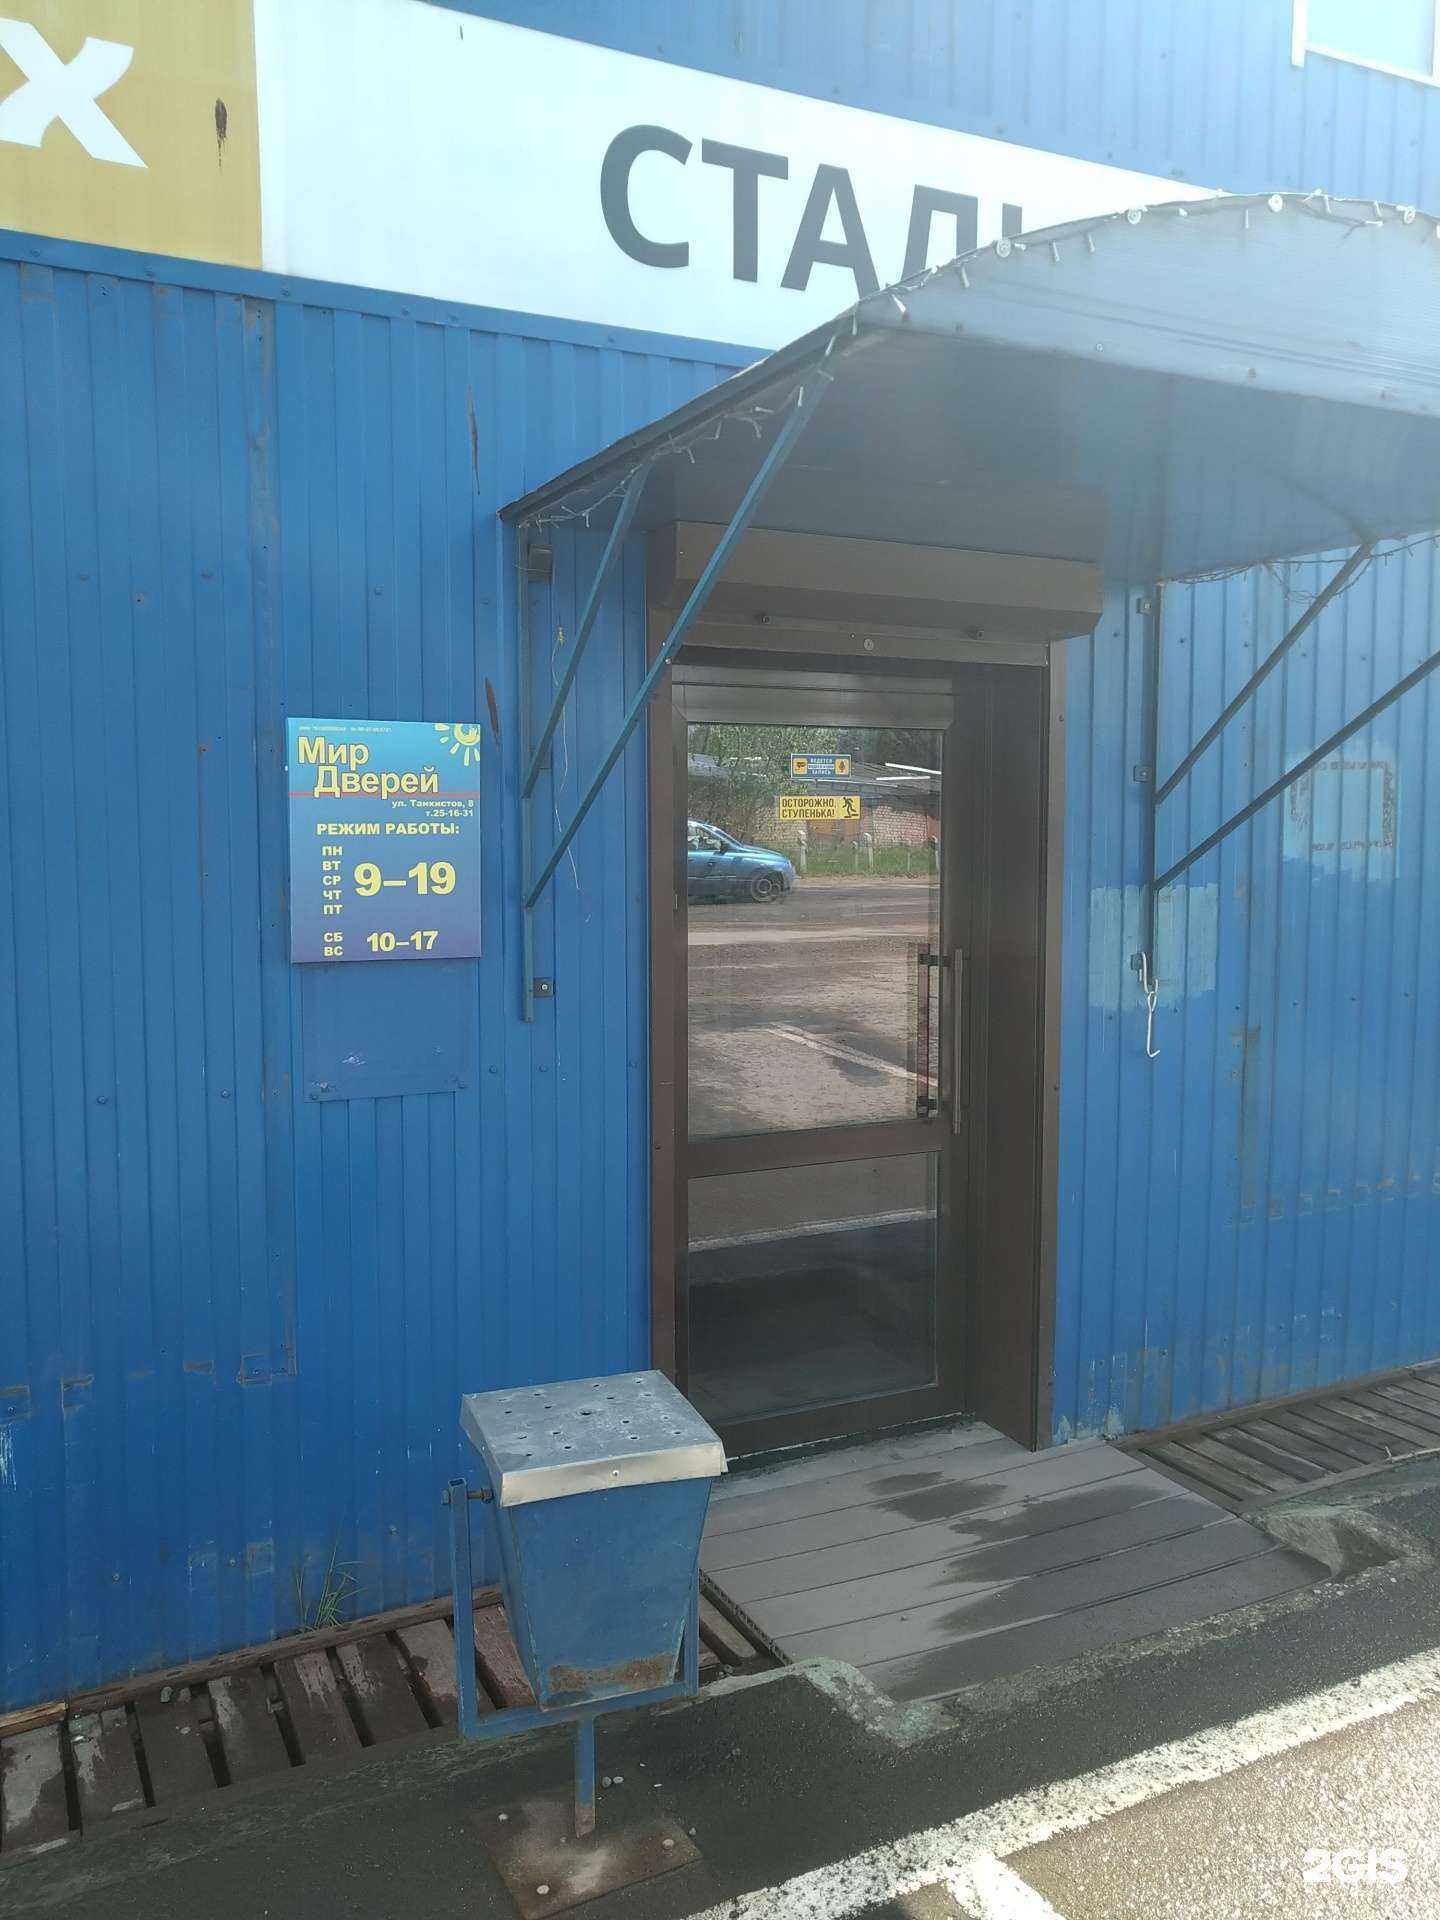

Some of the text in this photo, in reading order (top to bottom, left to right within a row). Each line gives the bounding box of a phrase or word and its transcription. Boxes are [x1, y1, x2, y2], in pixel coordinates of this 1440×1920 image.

[298, 736, 369, 770] Мир
[314, 765, 439, 800] Дверей
[392, 800, 407, 808] ул.
[782, 799, 836, 808] ОСТОРОЖНО,
[425, 809, 473, 817] т.25-16-31
[782, 809, 835, 818] СТУПЕНЬКА!
[317, 823, 459, 835] РЕЖИМ РАБОТЫ:
[322, 846, 342, 856] ПН
[322, 861, 341, 871] ВТ
[323, 876, 341, 885] СР
[323, 890, 342, 899] ЧТ
[324, 905, 342, 914] ПТ
[324, 932, 343, 942] СБ
[324, 946, 343, 956] ВС
